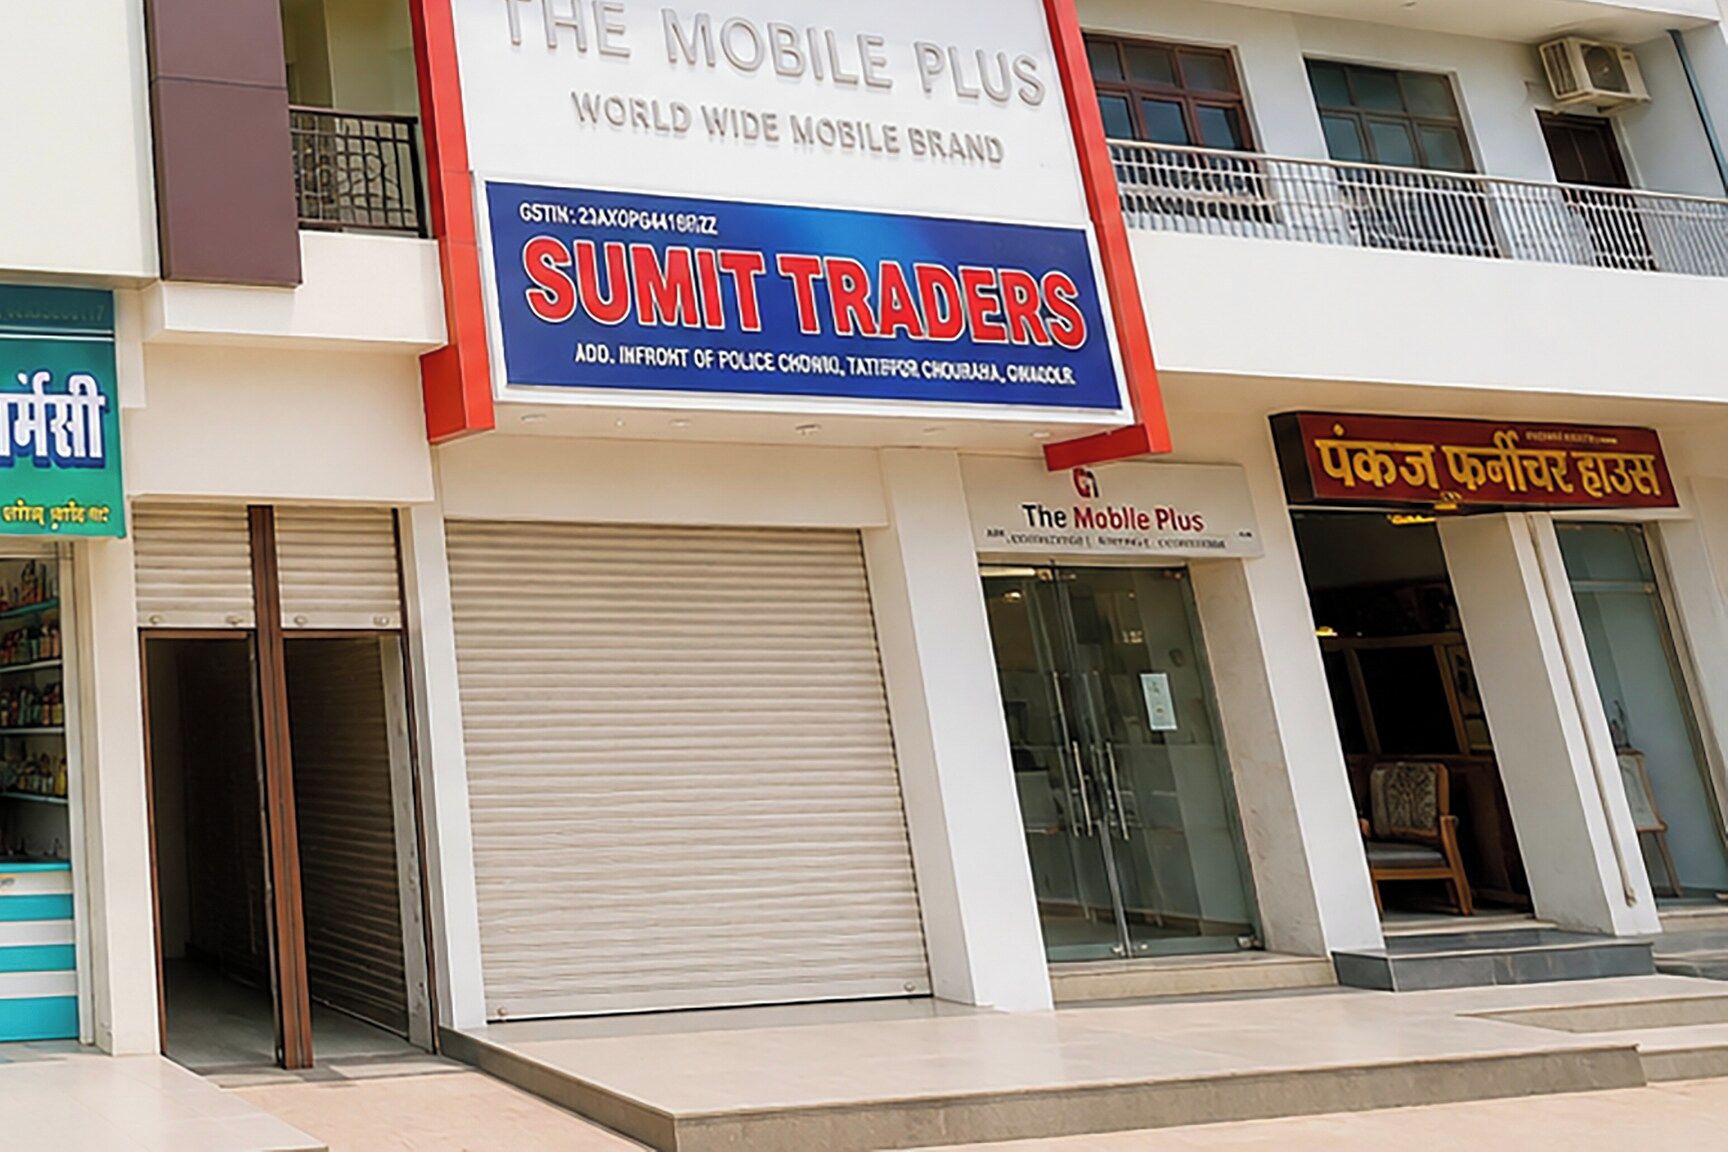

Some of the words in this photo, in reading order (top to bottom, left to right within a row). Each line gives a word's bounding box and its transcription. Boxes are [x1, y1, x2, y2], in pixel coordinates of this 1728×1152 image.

[661, 8, 894, 90] MOBILE
[913, 40, 1047, 107] PLUS
[572, 91, 692, 134] WORLD
[701, 105, 779, 143] WIDE
[791, 114, 901, 155] MOBILE
[908, 127, 1005, 164] BRAND
[522, 235, 766, 331] SUMIT
[776, 253, 1087, 350] TRADERS
[694, 349, 714, 369] OF
[719, 350, 775, 372] POLICE
[1314, 423, 1440, 489] पंकज
[1442, 430, 1573, 494] फर्नीचर
[1571, 451, 1662, 498] हाउस
[1022, 504, 1067, 529] The
[1154, 508, 1204, 533] Plus
